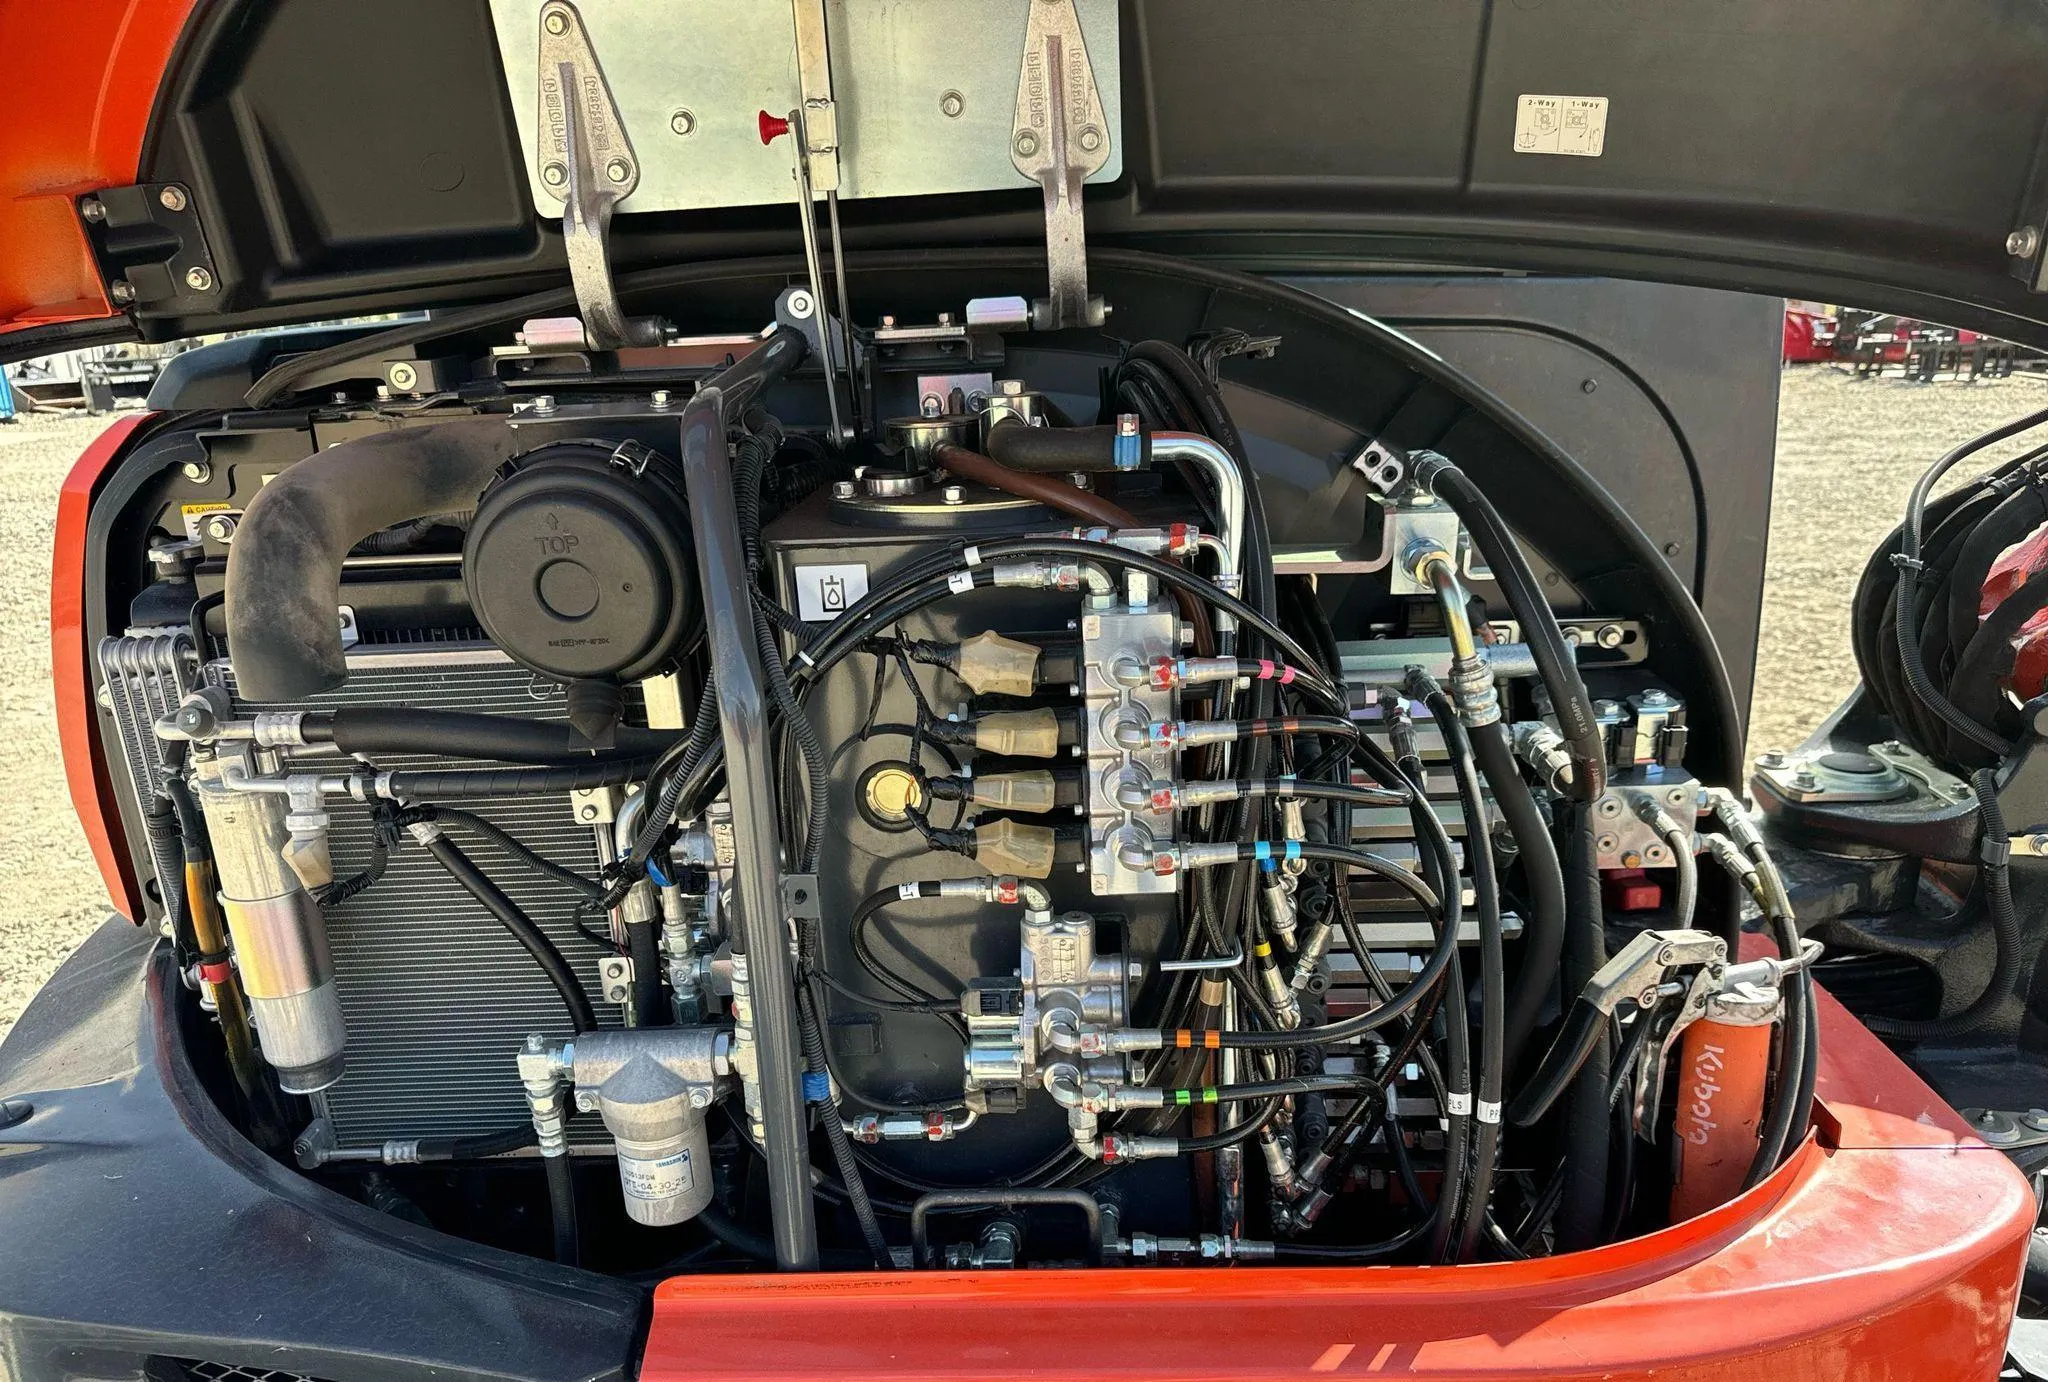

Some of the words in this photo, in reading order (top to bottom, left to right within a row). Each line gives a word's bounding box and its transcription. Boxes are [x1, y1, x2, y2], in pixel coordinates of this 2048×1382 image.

[1528, 99, 1556, 108] 2-Way
[1572, 101, 1600, 109] 1-Way
[534, 535, 579, 556] TOP
[1571, 696, 1588, 734] 21.0MPa
[1688, 1044, 1725, 1145] Kubota
